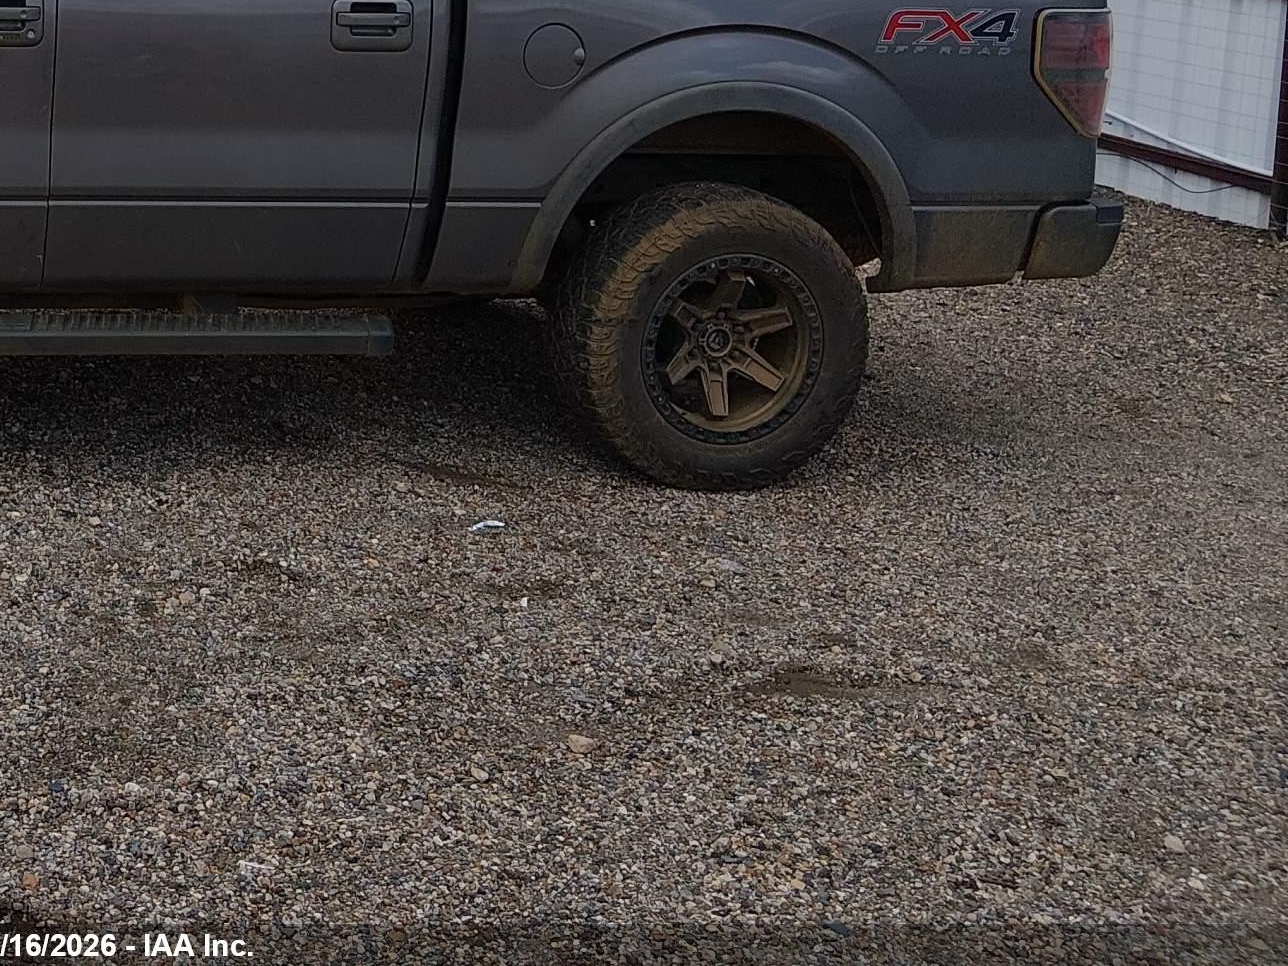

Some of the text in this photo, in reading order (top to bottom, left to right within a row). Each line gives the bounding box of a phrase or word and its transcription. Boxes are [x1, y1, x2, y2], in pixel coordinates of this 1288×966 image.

[878, 7, 1021, 46] FX4
[874, 45, 1012, 56] OFF ROAD
